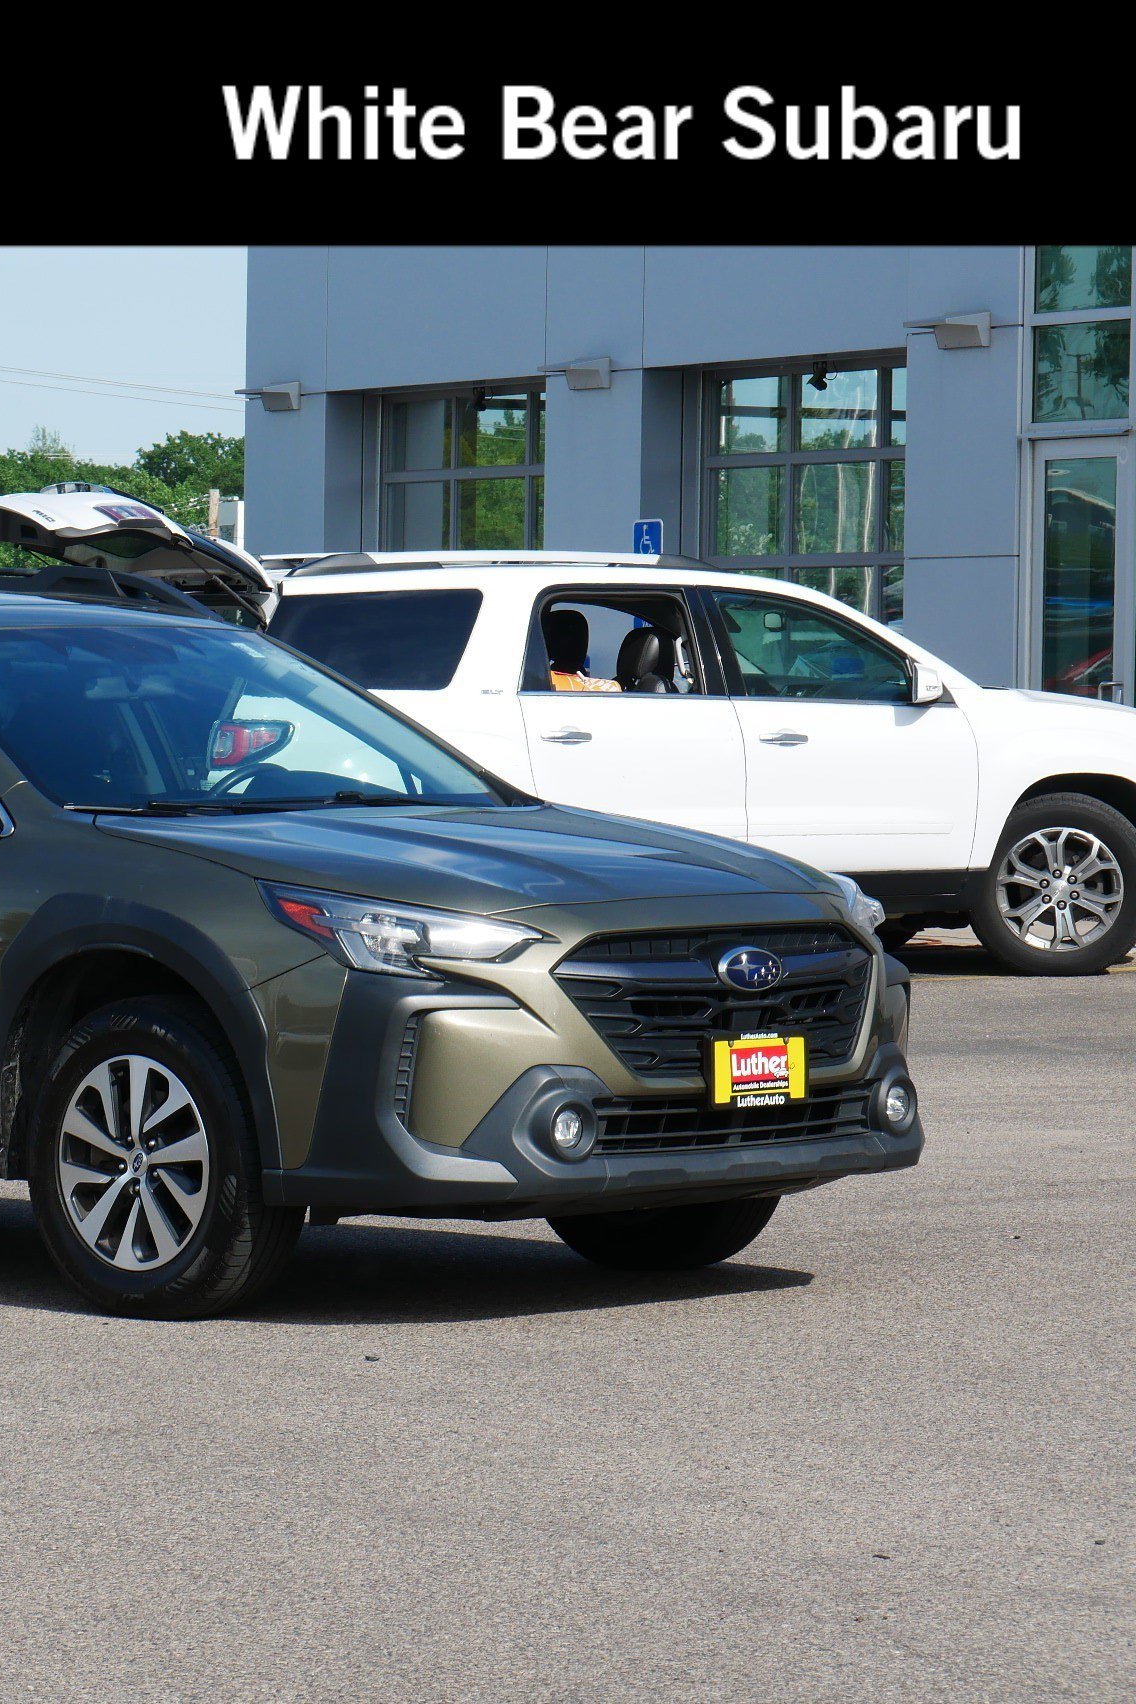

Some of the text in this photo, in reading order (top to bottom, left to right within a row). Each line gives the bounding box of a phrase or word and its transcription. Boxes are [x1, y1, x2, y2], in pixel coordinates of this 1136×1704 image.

[731, 1052, 788, 1077] Luther
[733, 1081, 788, 1091] Automobile Dealerships
[737, 1094, 785, 1107] LutherAuto
